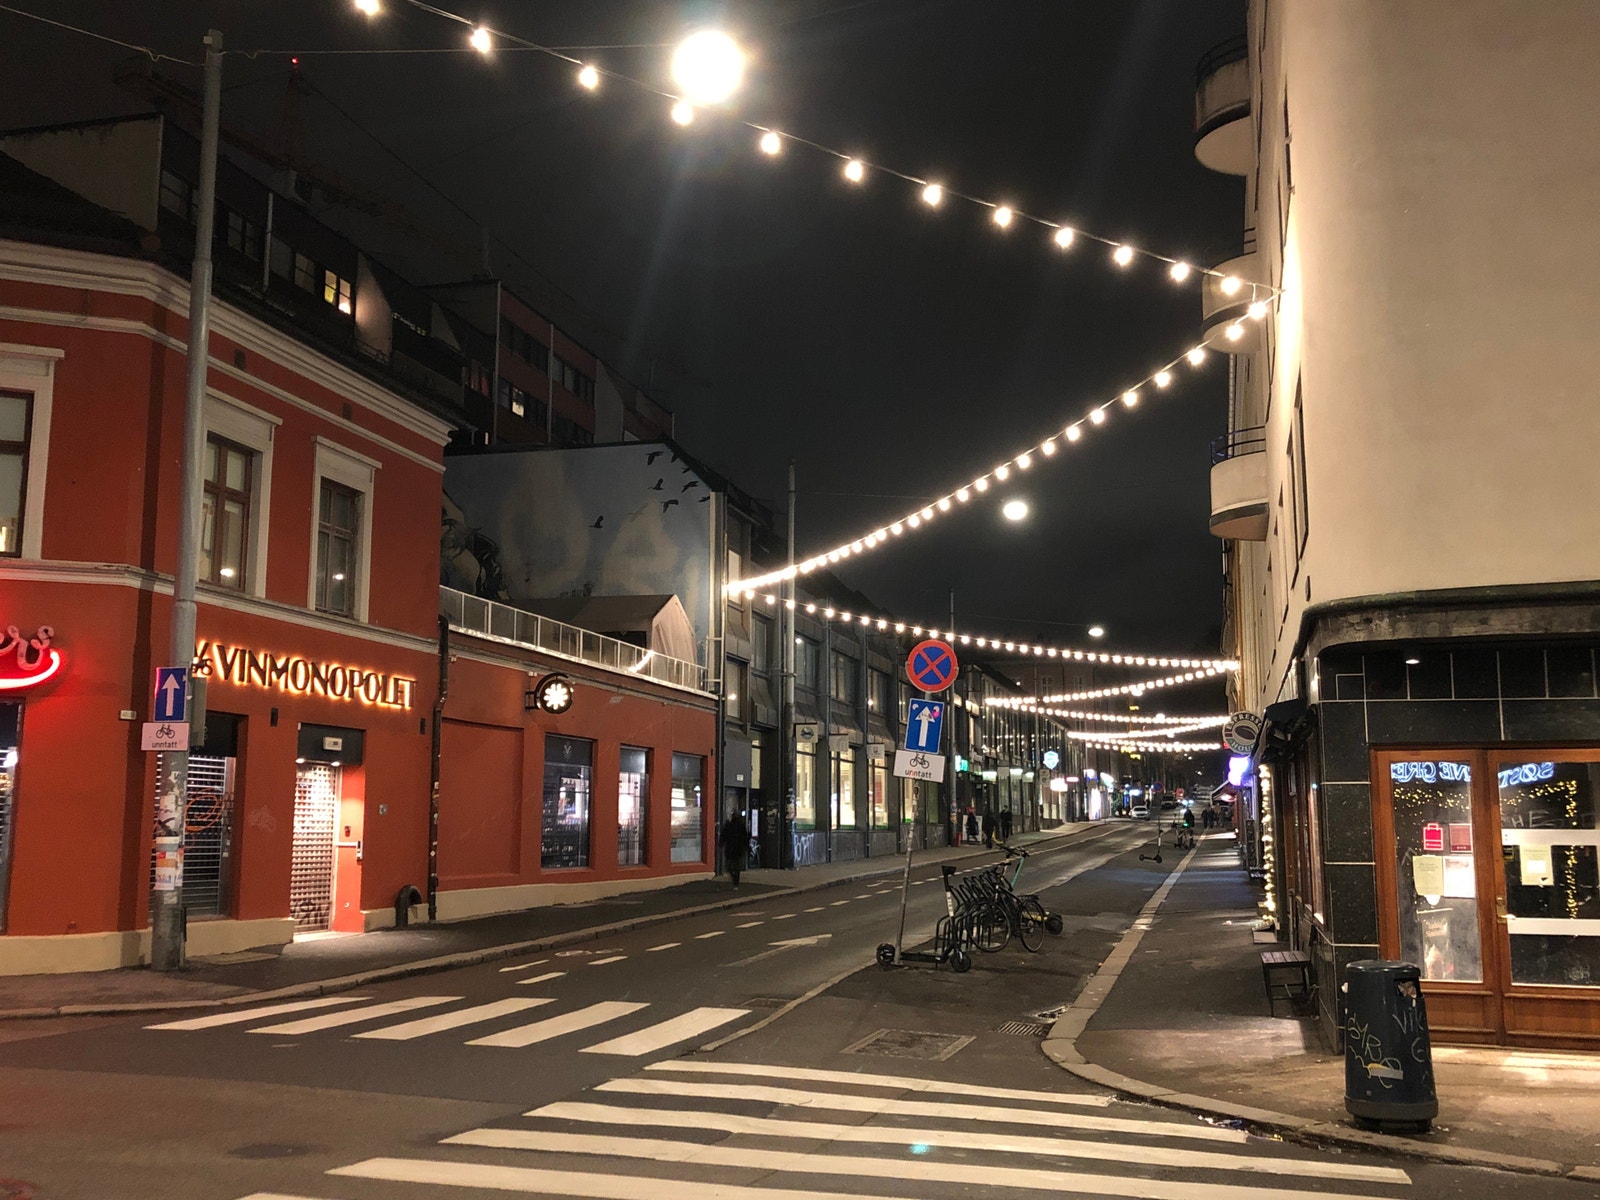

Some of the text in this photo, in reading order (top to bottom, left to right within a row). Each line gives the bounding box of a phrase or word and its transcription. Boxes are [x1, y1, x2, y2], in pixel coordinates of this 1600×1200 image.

[216, 644, 418, 708] VINMONOPOLET
[152, 741, 178, 749] unntatt
[1231, 741, 1255, 751] HOU
[905, 769, 932, 779] unntatt
